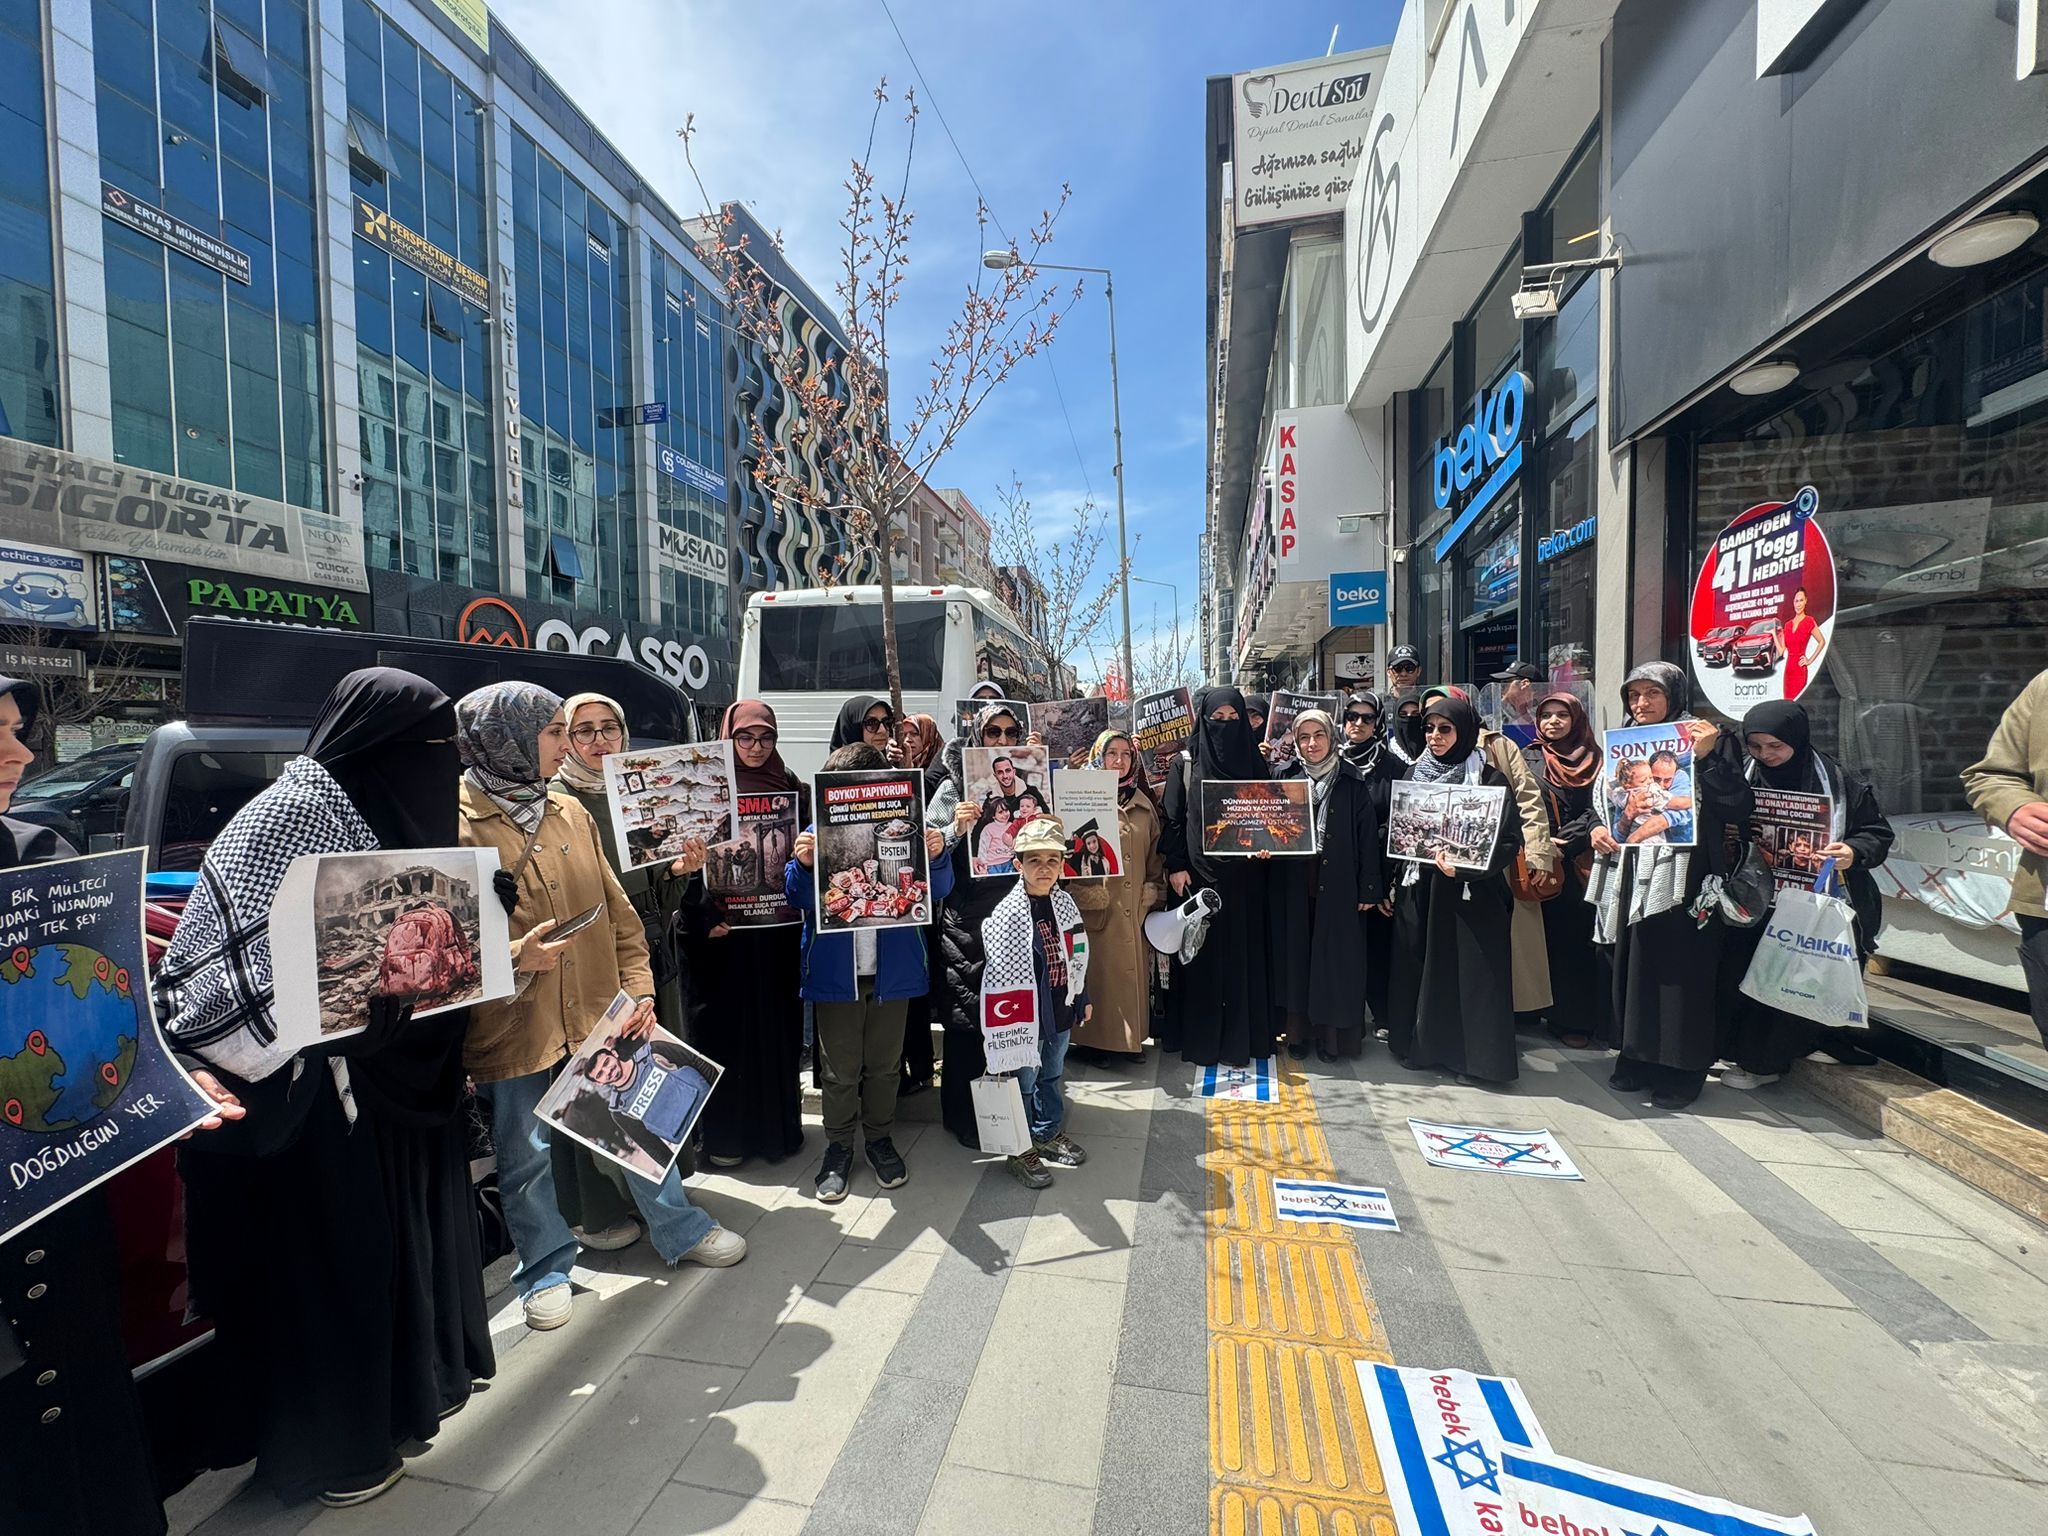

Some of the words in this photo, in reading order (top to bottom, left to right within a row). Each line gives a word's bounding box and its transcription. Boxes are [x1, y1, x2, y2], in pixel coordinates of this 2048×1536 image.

[1248, 121, 1285, 142] Dijital
[1287, 114, 1326, 133] Dental
[1252, 153, 1317, 178] Ağzınıza
[1245, 181, 1320, 209] Gülüşünüze
[134, 204, 172, 231] ERTAŞ
[176, 224, 248, 270] MÜHENDİSLİK
[1434, 371, 1524, 510] beko
[25, 451, 124, 488] HACI
[136, 474, 252, 513] TUGAY
[1280, 426, 1296, 557] KASAP
[308, 529, 351, 546] NEOVA
[1538, 516, 1596, 563] beko.com
[1, 550, 40, 562] ethica
[42, 556, 82, 568] sigorta
[1712, 544, 1752, 593] 41
[1754, 531, 1799, 560] Togg
[316, 562, 349, 575] QUICK
[187, 579, 360, 625] PAPATYA
[1336, 586, 1380, 602] beko
[6, 652, 18, 667] İŞ
[21, 655, 73, 668] MERKEZİ
[1734, 682, 1768, 696] bambi
[1143, 695, 1177, 717] ZULME
[1276, 706, 1298, 715] BEBEK
[1292, 697, 1319, 709] İÇİNDE
[1137, 714, 1162, 730] ORTAK
[1140, 726, 1160, 739] KANLI
[1140, 730, 1177, 751] BOYKOT
[1610, 742, 1648, 759] SON
[828, 788, 860, 801] BOYKOT
[860, 784, 909, 798] YAPIYORUM
[830, 804, 849, 815] ÇÜNKÜ
[886, 800, 902, 809] SUÇA
[1766, 800, 1821, 813] ONAYLADILAR!
[830, 812, 849, 823] ORTAK
[850, 812, 871, 821] OLMAYI
[881, 846, 908, 857] EPSTEIN
[48, 874, 108, 899] MÜLTECİ
[52, 892, 114, 914] İNSANDAN
[744, 908, 776, 916] OLAMAZ!
[40, 918, 69, 937] TEK
[1766, 925, 1794, 942] LC
[992, 1026, 1029, 1040] HEPİMİZ
[632, 1070, 663, 1116] PRESS
[10, 1118, 120, 1190] DOĞDUĞUN
[124, 1094, 165, 1119] YER
[1282, 1195, 1318, 1205] bebek
[1352, 1201, 1386, 1211] katili
[1430, 1374, 1471, 1438] bebek
